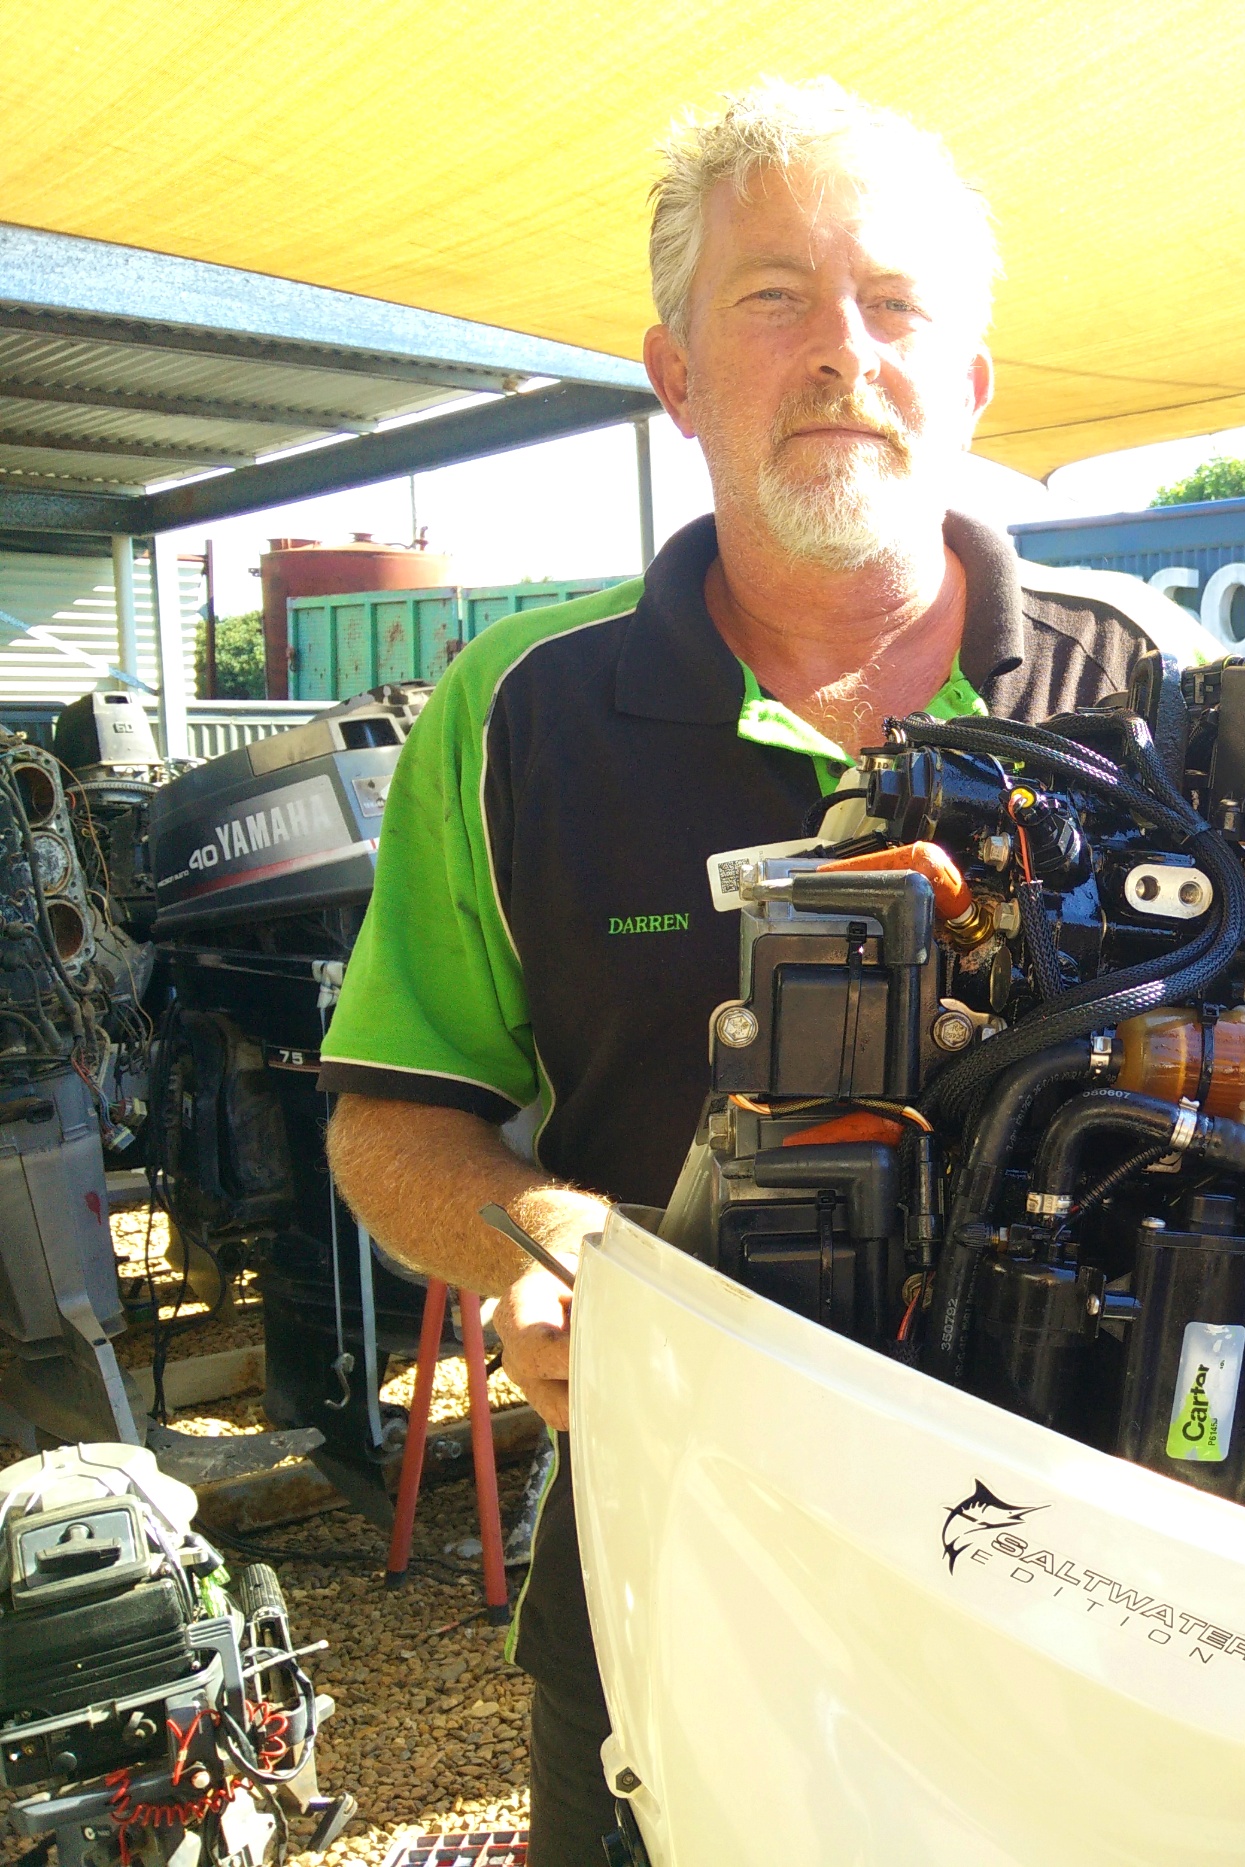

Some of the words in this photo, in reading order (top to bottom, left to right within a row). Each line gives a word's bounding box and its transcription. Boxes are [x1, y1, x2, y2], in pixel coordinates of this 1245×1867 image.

[215, 795, 331, 862] YAMAHA
[188, 843, 219, 870] 40
[608, 912, 689, 935] DARREN
[279, 1049, 303, 1065] 75
[1082, 1088, 1131, 1100] 080607
[940, 1298, 959, 1352] 350792
[1181, 1363, 1211, 1442] Carter
[969, 1548, 1214, 1664] EDITION
